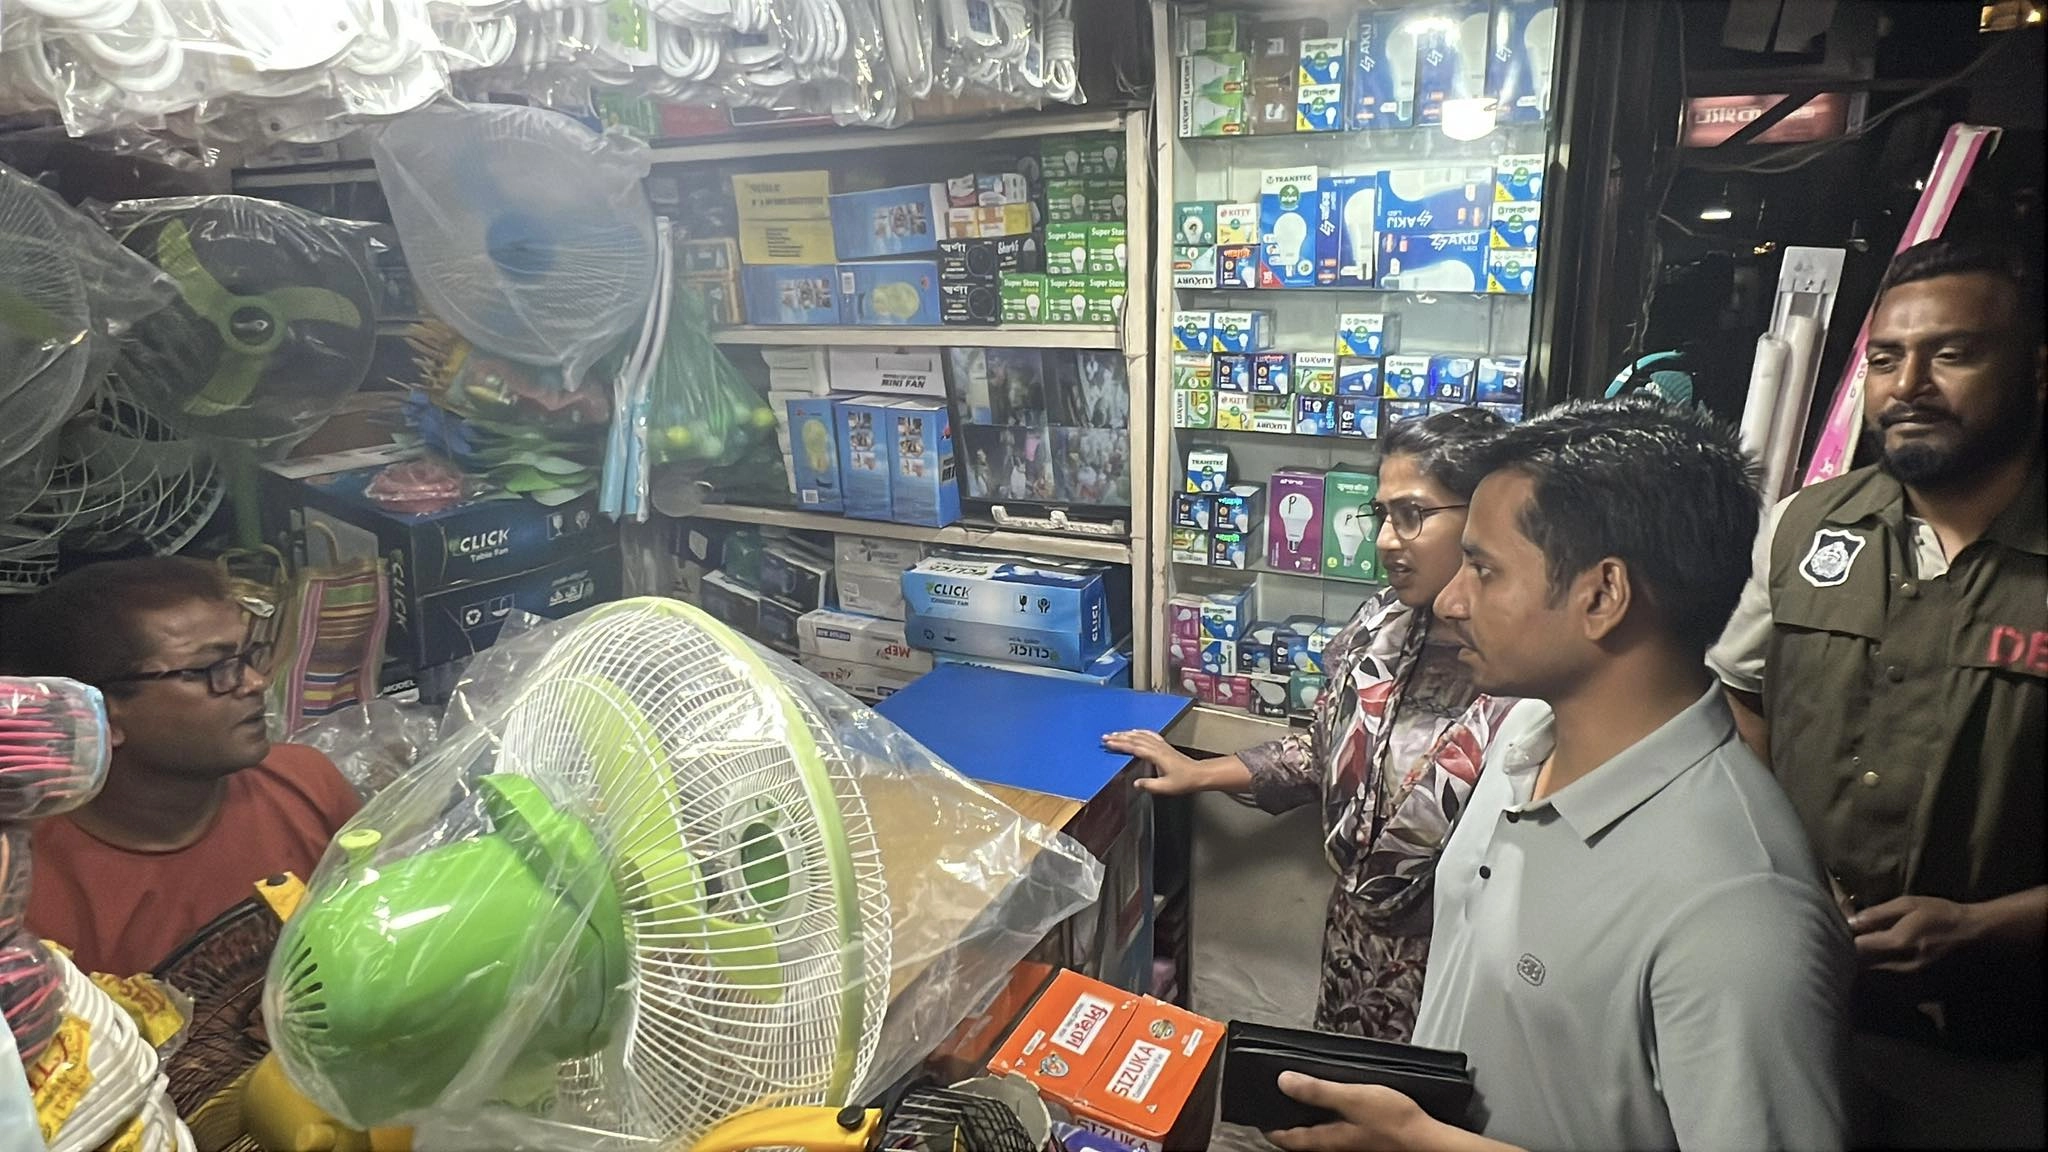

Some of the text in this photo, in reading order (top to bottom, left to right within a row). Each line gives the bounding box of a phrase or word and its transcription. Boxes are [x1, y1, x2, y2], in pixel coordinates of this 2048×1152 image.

[1360, 24, 1372, 54] AKIJ
[1275, 175, 1312, 183] TRANSTEC
[1228, 208, 1252, 217] KITTY
[1386, 216, 1418, 228] AKIJ
[1048, 232, 1066, 241] Super
[1091, 227, 1126, 238] Super Stor
[1447, 233, 1480, 245] AKIJ
[1004, 279, 1021, 288] Super
[1050, 279, 1067, 289] Super
[1089, 279, 1108, 289] Super
[1299, 356, 1333, 364] LUXURY
[905, 379, 926, 388] FAN
[1176, 393, 1184, 424] LUXURY
[460, 527, 510, 552] CLICK
[934, 583, 973, 597] CLICK
[1008, 642, 1050, 659] CLICK
[1112, 1046, 1156, 1097] SIZUKA
